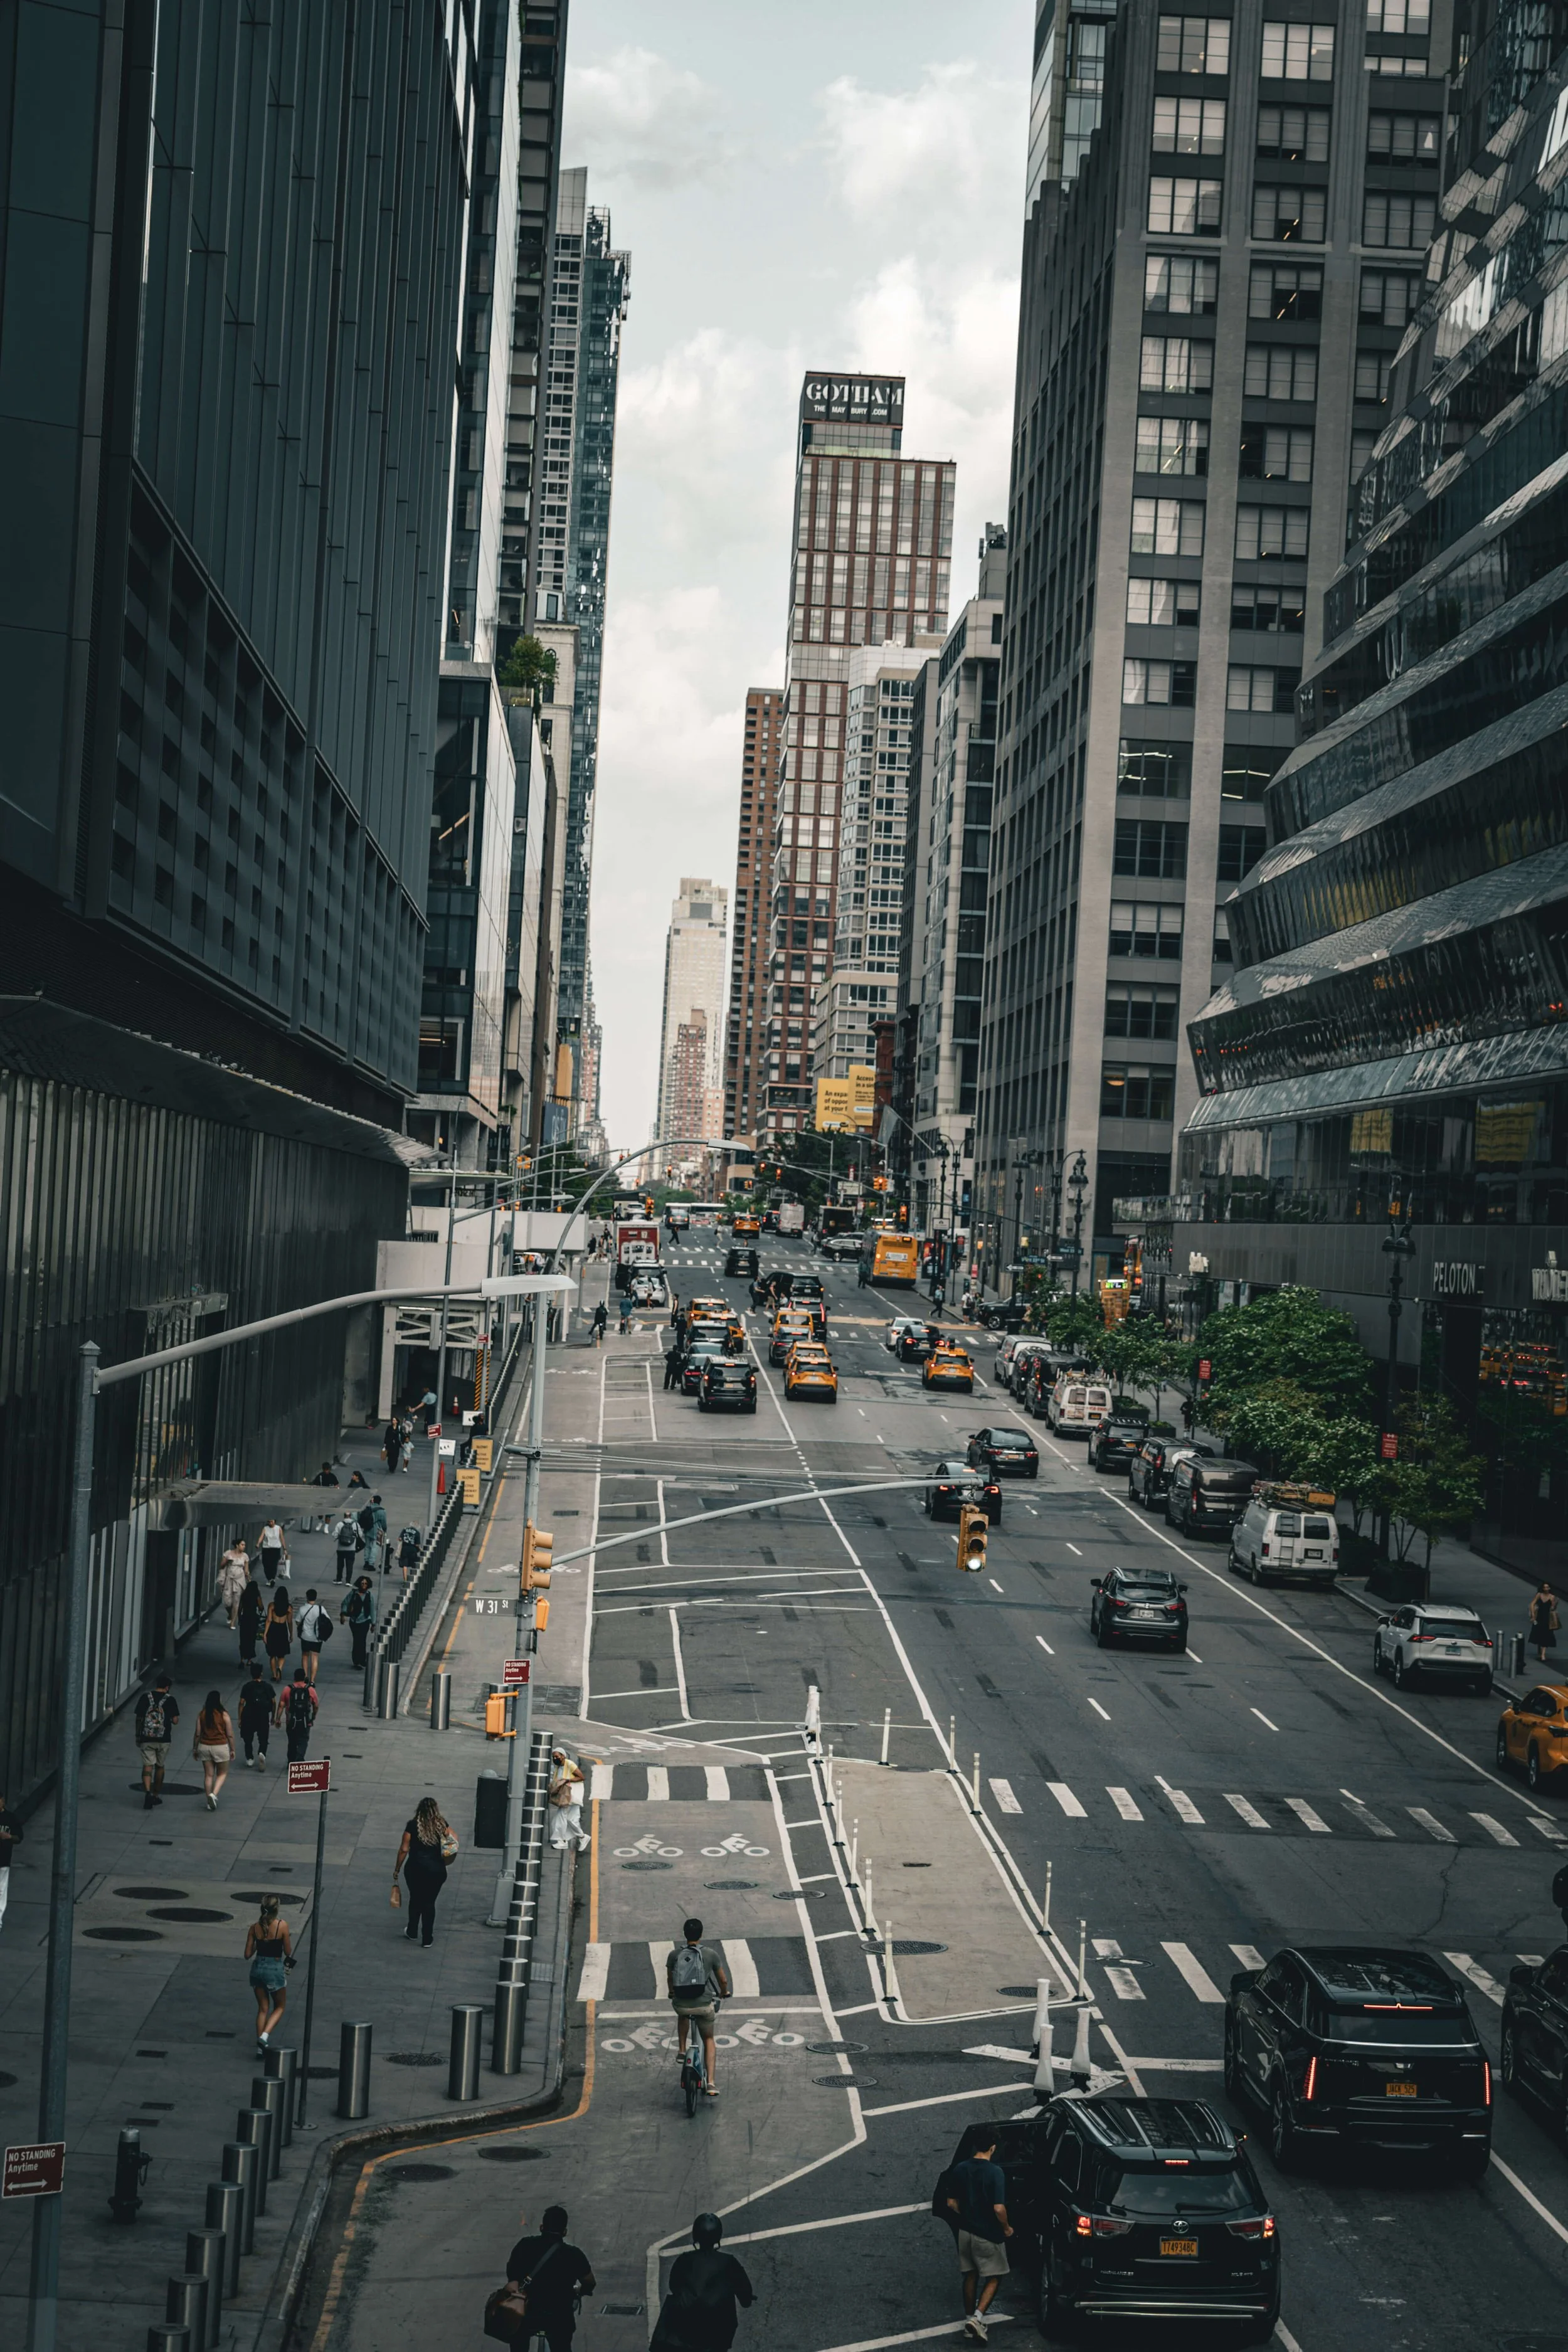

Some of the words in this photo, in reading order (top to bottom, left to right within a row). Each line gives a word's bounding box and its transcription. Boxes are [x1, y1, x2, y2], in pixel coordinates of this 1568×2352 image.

[806, 383, 903, 406] GOTHAM
[832, 406, 845, 414] MAY
[1433, 1262, 1476, 1295] PELOTON
[475, 1599, 484, 1613] W
[487, 1600, 497, 1614] 31
[502, 1599, 509, 1608] St
[1388, 2084, 1401, 2094] JACK
[9, 2153, 19, 2162] NO
[21, 2149, 56, 2161] STANDING
[8, 2163, 38, 2175] Anytime
[1163, 2242, 1194, 2253] T749348C
